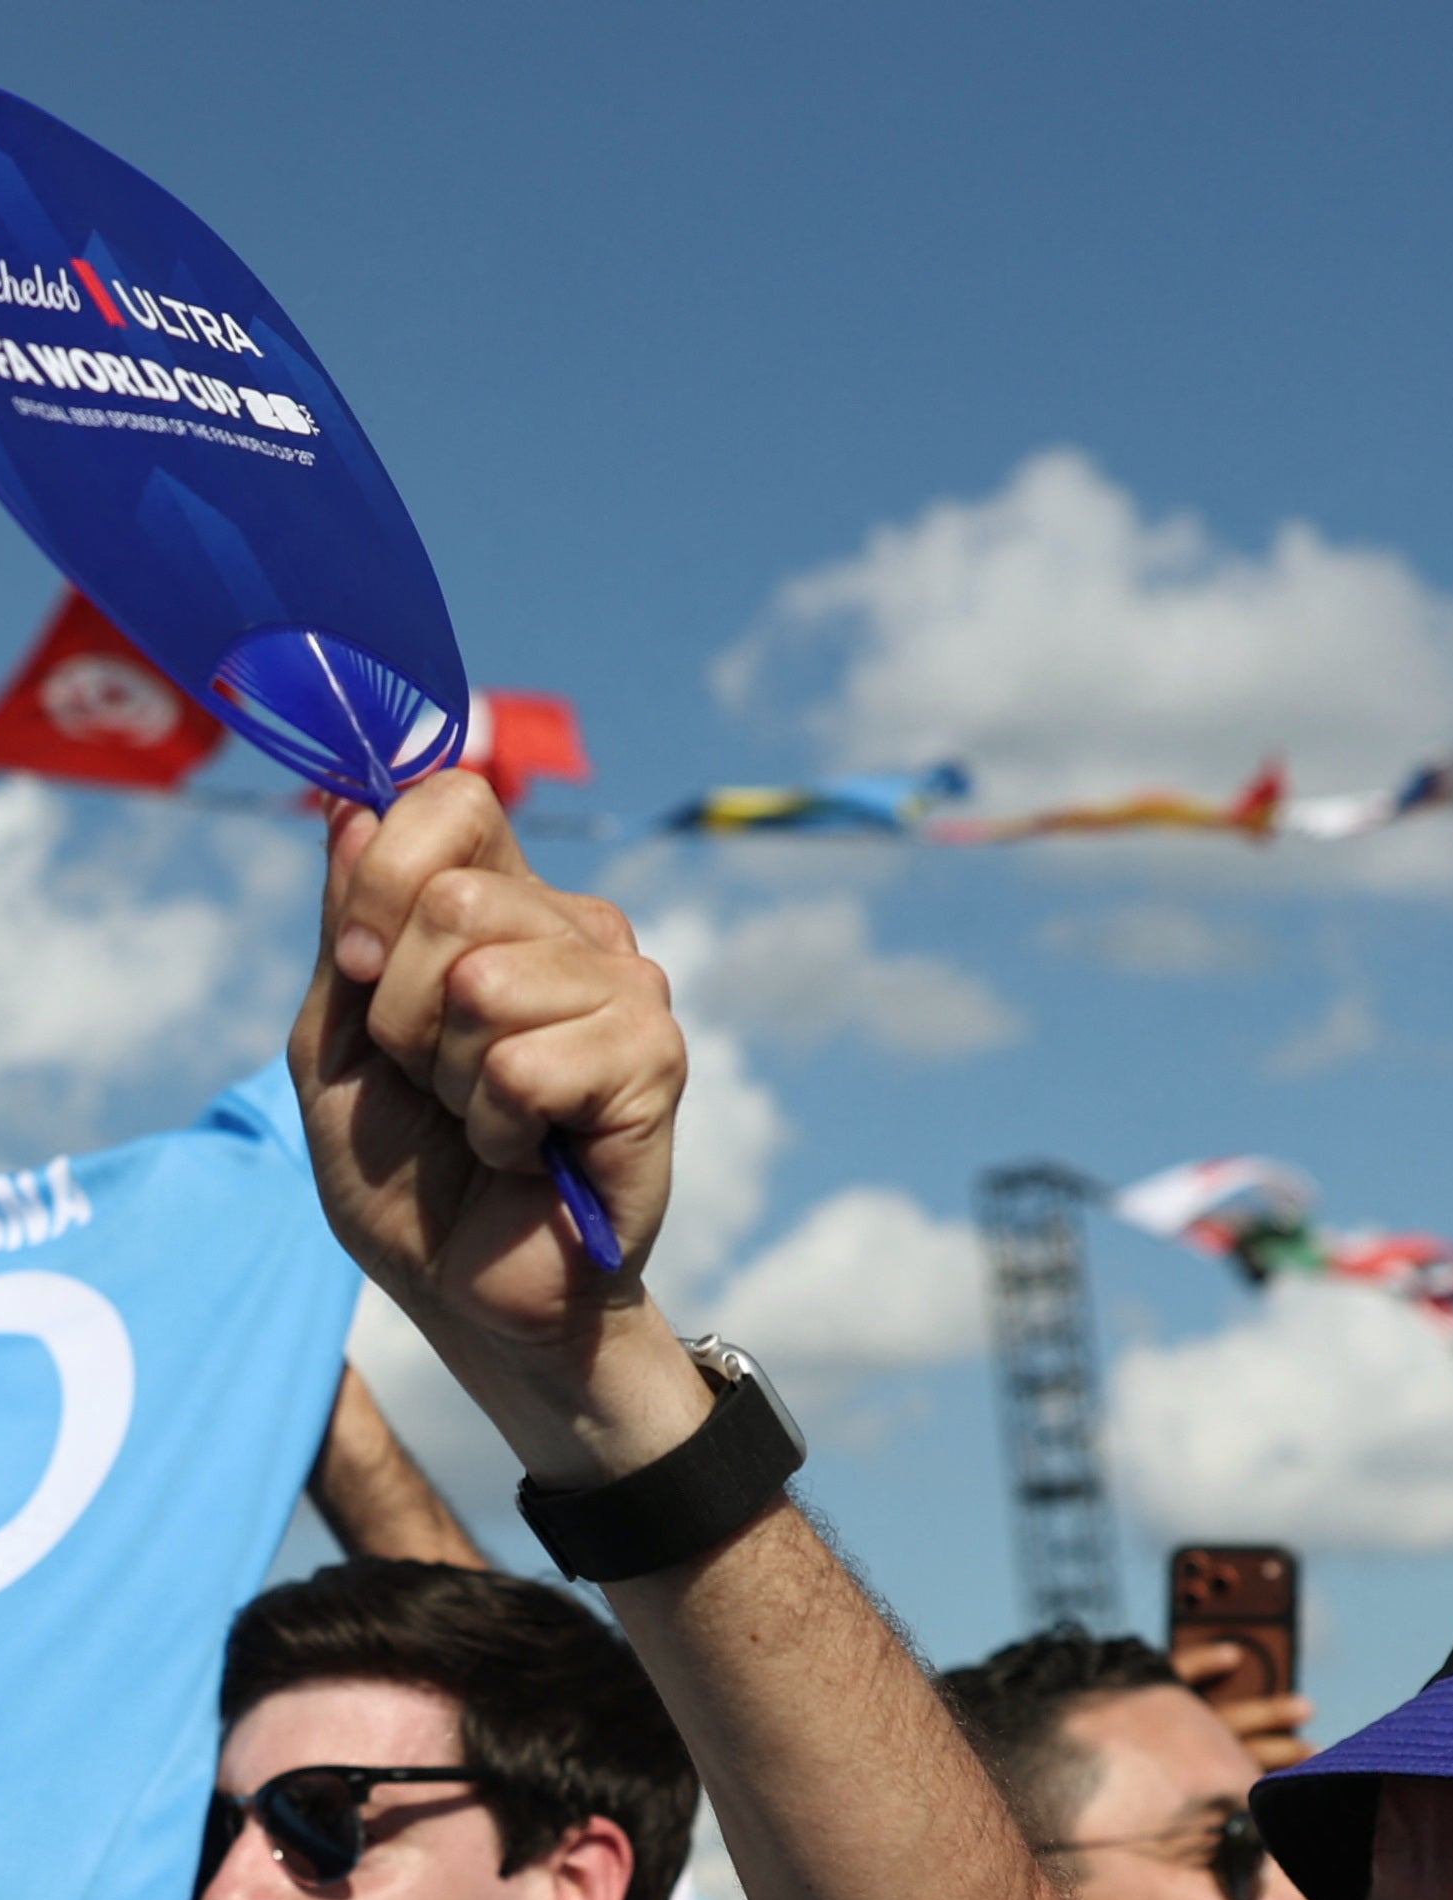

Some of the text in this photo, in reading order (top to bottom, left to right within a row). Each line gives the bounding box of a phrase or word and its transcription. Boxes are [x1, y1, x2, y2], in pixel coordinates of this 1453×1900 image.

[112, 279, 264, 358] ULTRA
[26, 342, 180, 402] WORLD
[173, 367, 242, 419] CUP
